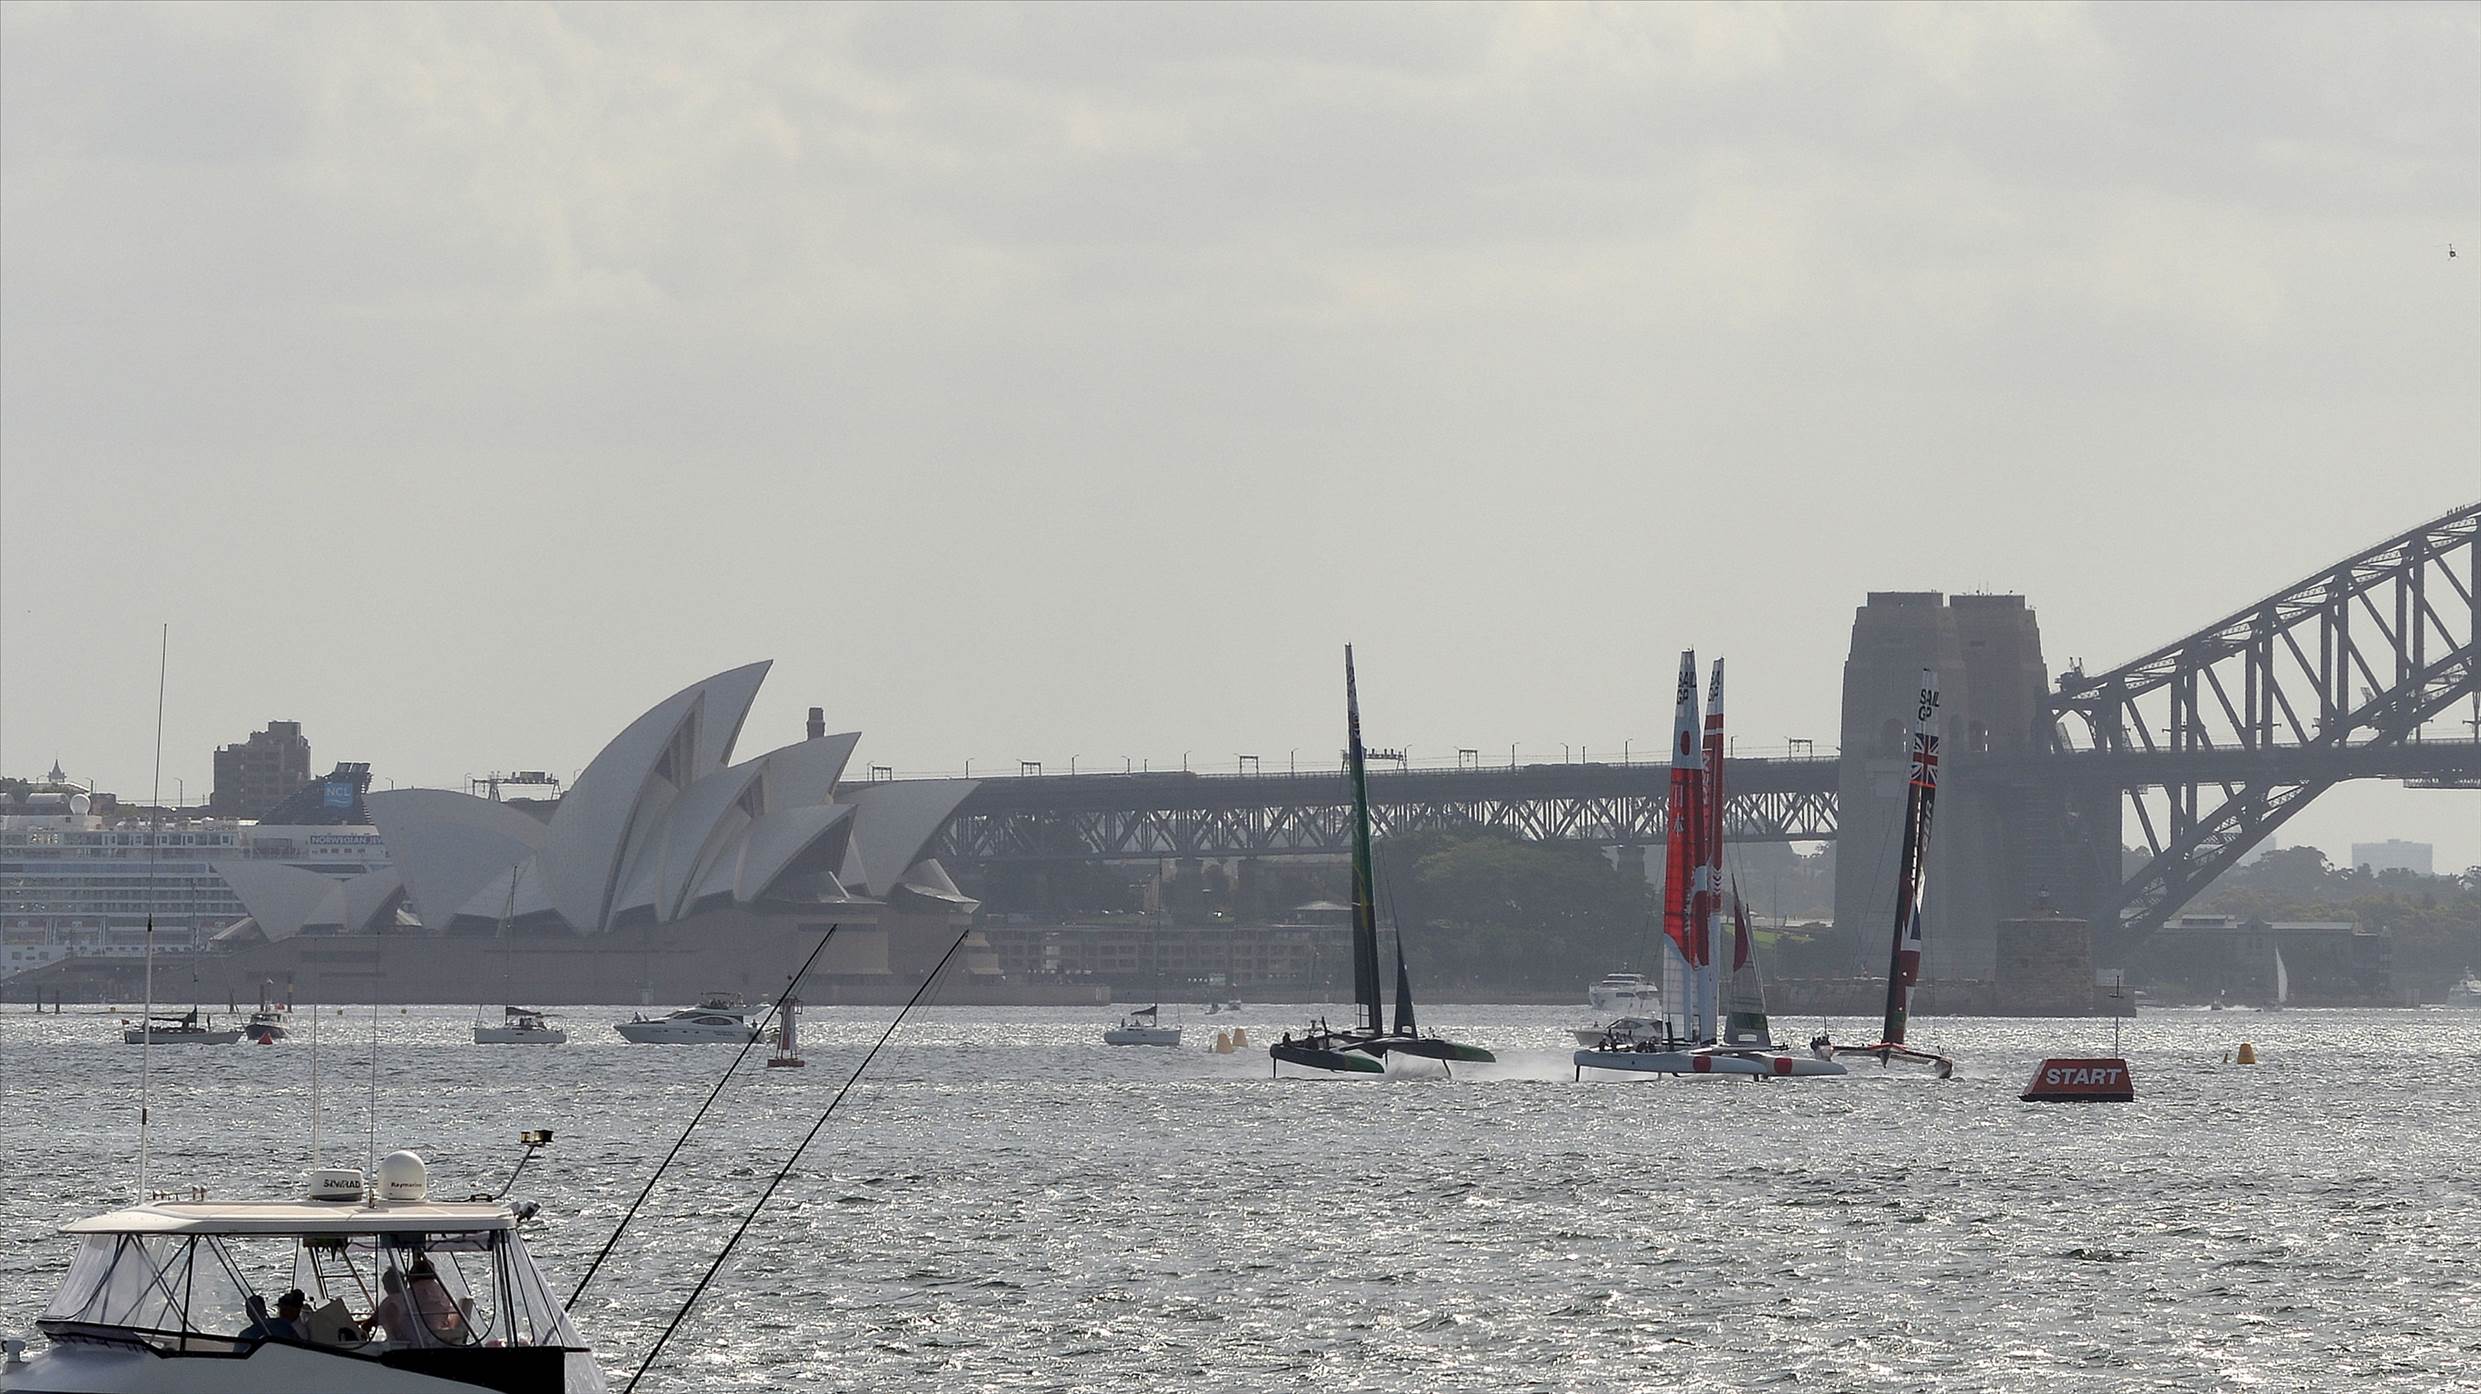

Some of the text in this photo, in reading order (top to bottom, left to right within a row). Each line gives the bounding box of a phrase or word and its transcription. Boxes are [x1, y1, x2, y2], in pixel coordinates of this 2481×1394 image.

[1677, 688, 1688, 704] GP
[1920, 689, 1940, 707] SAIL
[1918, 705, 1932, 721] GP
[326, 785, 351, 797] NCL
[2046, 1068, 2122, 1085] START
[323, 1179, 361, 1189] SIMRAD
[390, 1181, 422, 1189] Raymarine
